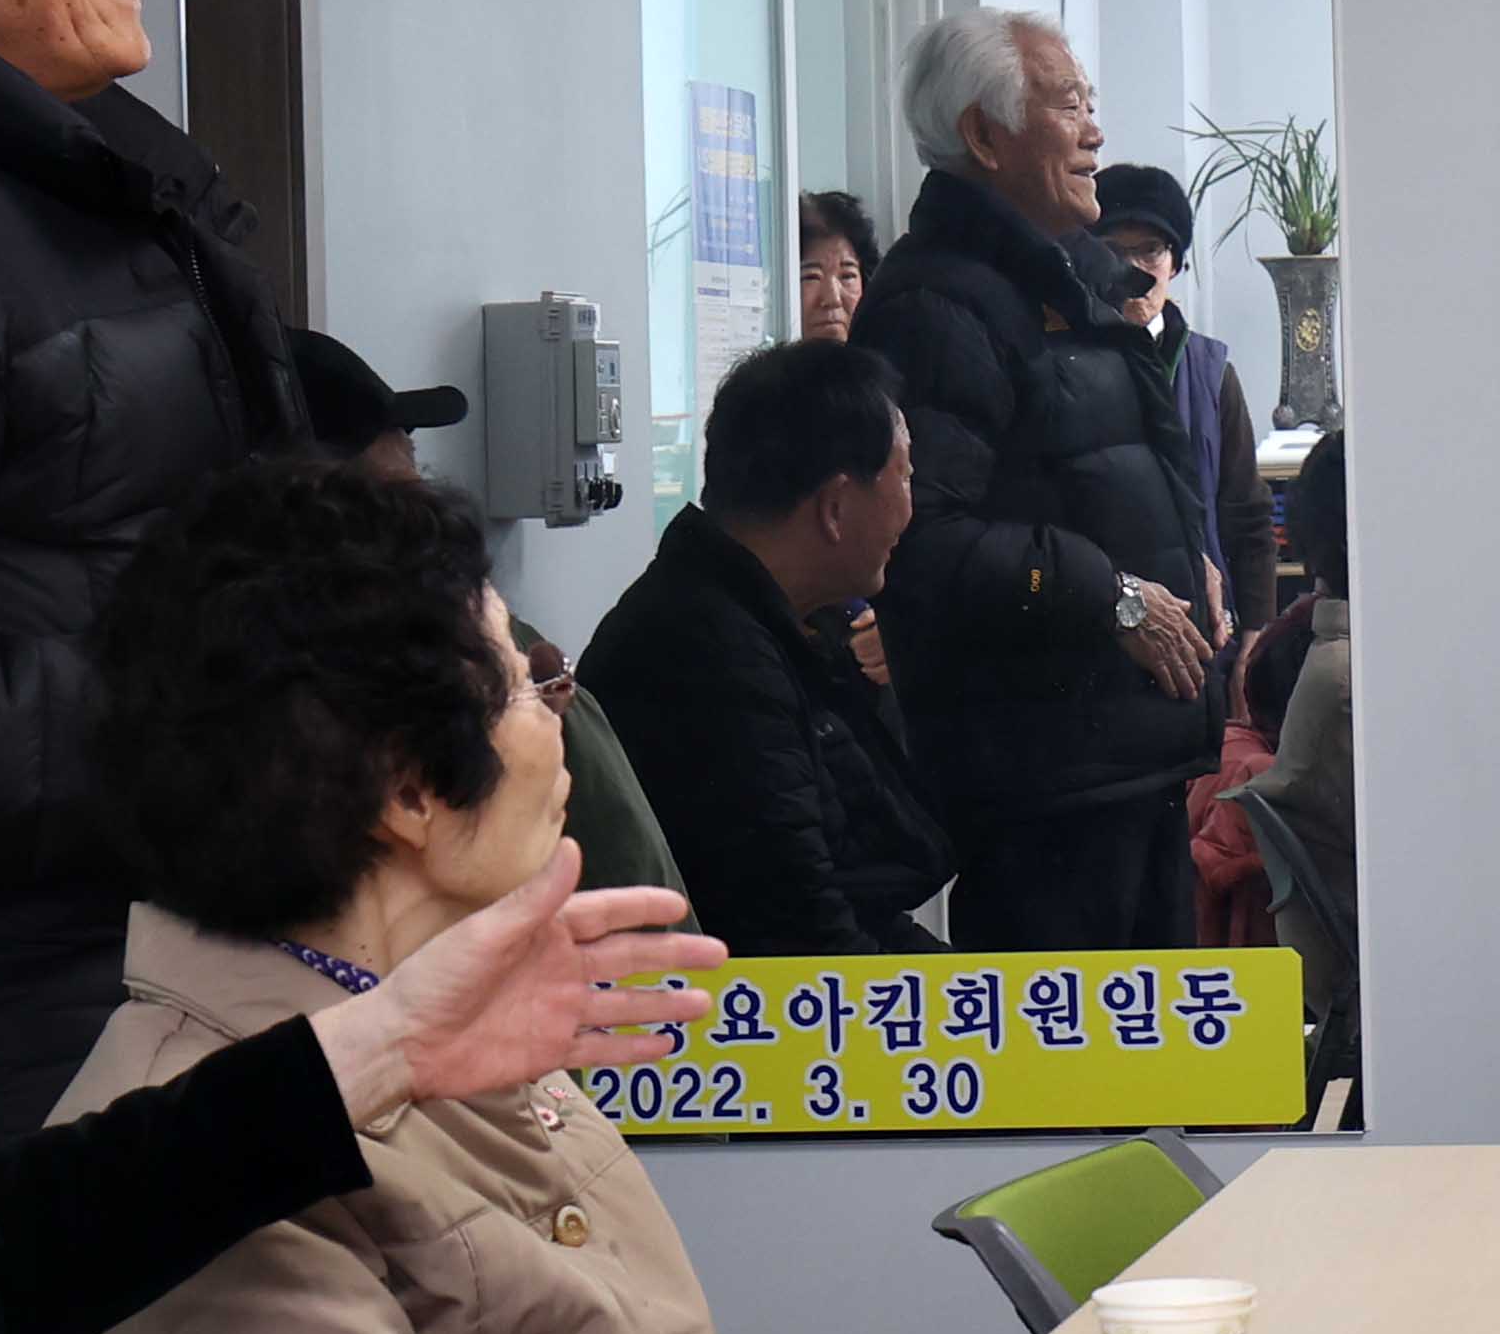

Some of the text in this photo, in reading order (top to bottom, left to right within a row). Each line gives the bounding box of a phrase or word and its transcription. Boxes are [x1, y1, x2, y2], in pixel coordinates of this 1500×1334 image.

[595, 969, 1243, 1055] 요아킴회원일동
[591, 1061, 980, 1119] 2022. 3. 30
